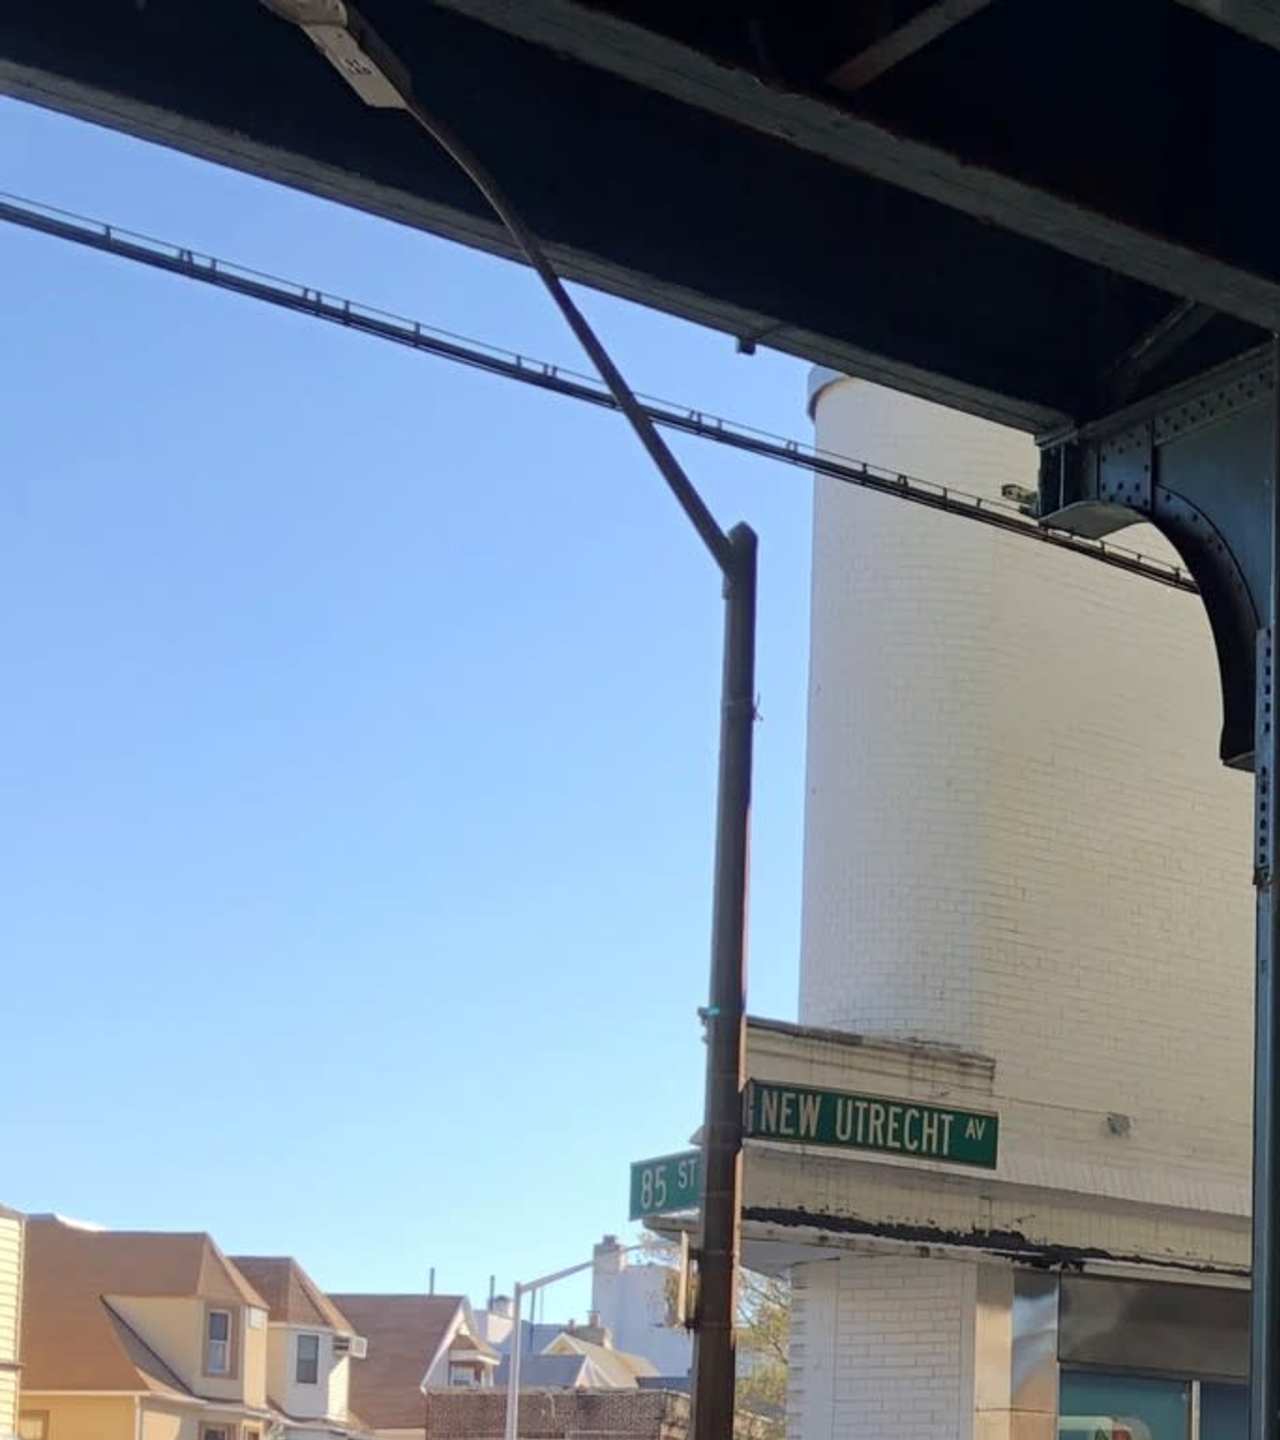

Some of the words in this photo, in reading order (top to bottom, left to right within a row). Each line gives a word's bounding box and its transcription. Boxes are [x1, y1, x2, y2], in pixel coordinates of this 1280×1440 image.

[760, 1090, 821, 1138] NEW
[835, 1097, 955, 1156] UTRECHT
[965, 1117, 986, 1142] AV
[641, 1165, 667, 1209] 85
[678, 1158, 697, 1189] ST
